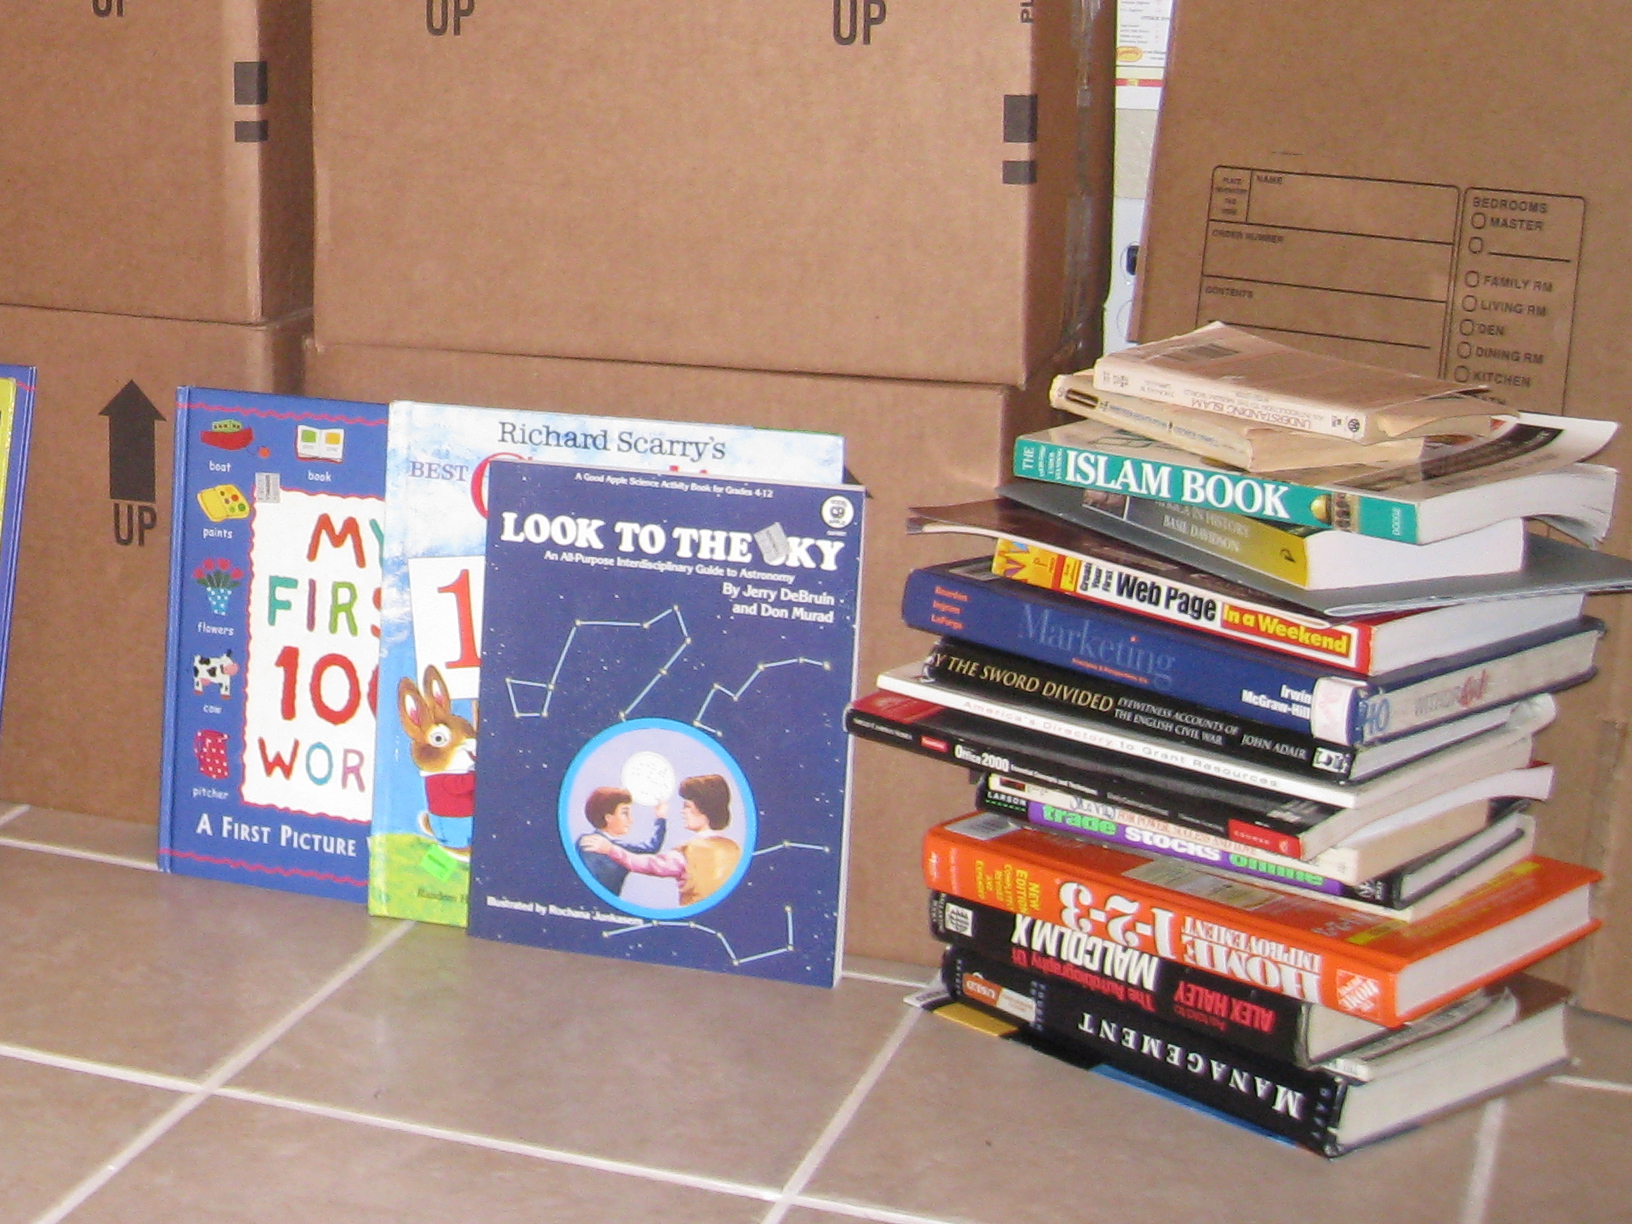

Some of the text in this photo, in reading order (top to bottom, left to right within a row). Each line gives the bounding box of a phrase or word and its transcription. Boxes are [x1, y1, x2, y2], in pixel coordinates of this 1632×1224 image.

[1473, 197, 1548, 213] BEDROOMS
[1490, 217, 1544, 231] MASTER
[1484, 275, 1553, 292] FAMILY RM
[1481, 300, 1546, 317] LIVING RM
[1478, 323, 1504, 335] DEN
[1476, 347, 1544, 364] DINING RM
[1191, 398, 1224, 413] ISLAM
[1225, 404, 1312, 430] UNDERSTANDING
[498, 421, 727, 464] Richard Scarry's
[208, 459, 231, 474] boat
[306, 469, 332, 484] book
[410, 460, 469, 483] BEST
[1021, 447, 1035, 470] THE
[1066, 450, 1172, 499] ISLAM
[1182, 471, 1291, 519] BOOK
[112, 502, 158, 547] UP
[202, 526, 234, 540] paints
[500, 511, 606, 550] LOOK
[615, 521, 666, 554] TO
[672, 527, 753, 563] THE
[544, 548, 796, 584] An All-Purpose Interdisciplinary Guide to Astronomy
[722, 582, 834, 605] By Jerry DeBruin
[732, 602, 834, 624] and Don Murad
[1116, 571, 1349, 654] Web Page In a Weekend
[197, 620, 235, 638] flowers
[1019, 604, 1177, 689] Marketing
[275, 644, 377, 722] 10
[947, 656, 978, 677] THE
[980, 664, 1040, 692] SWORD
[1042, 681, 1114, 712] DIVIDED
[202, 703, 223, 714] cow
[1241, 683, 1312, 720] Irwin McGraw-Hill
[1114, 709, 1224, 746] THE ENGLISH CIVIL WAR
[954, 745, 1009, 771] Office 2000
[1241, 734, 1307, 760] JOHN ADAIR
[192, 784, 229, 801] pitcher
[197, 813, 357, 857] A FIRST PICTURE
[1043, 803, 1118, 837] trade
[1125, 825, 1222, 862] stocks
[1010, 913, 1160, 992] MALCOLM X
[1058, 881, 1325, 1005] HOME IMPROVEMENT 1-2-3
[1173, 980, 1276, 1034] ALEX HALEY
[1077, 1012, 1306, 1120] MANAGEMENT
